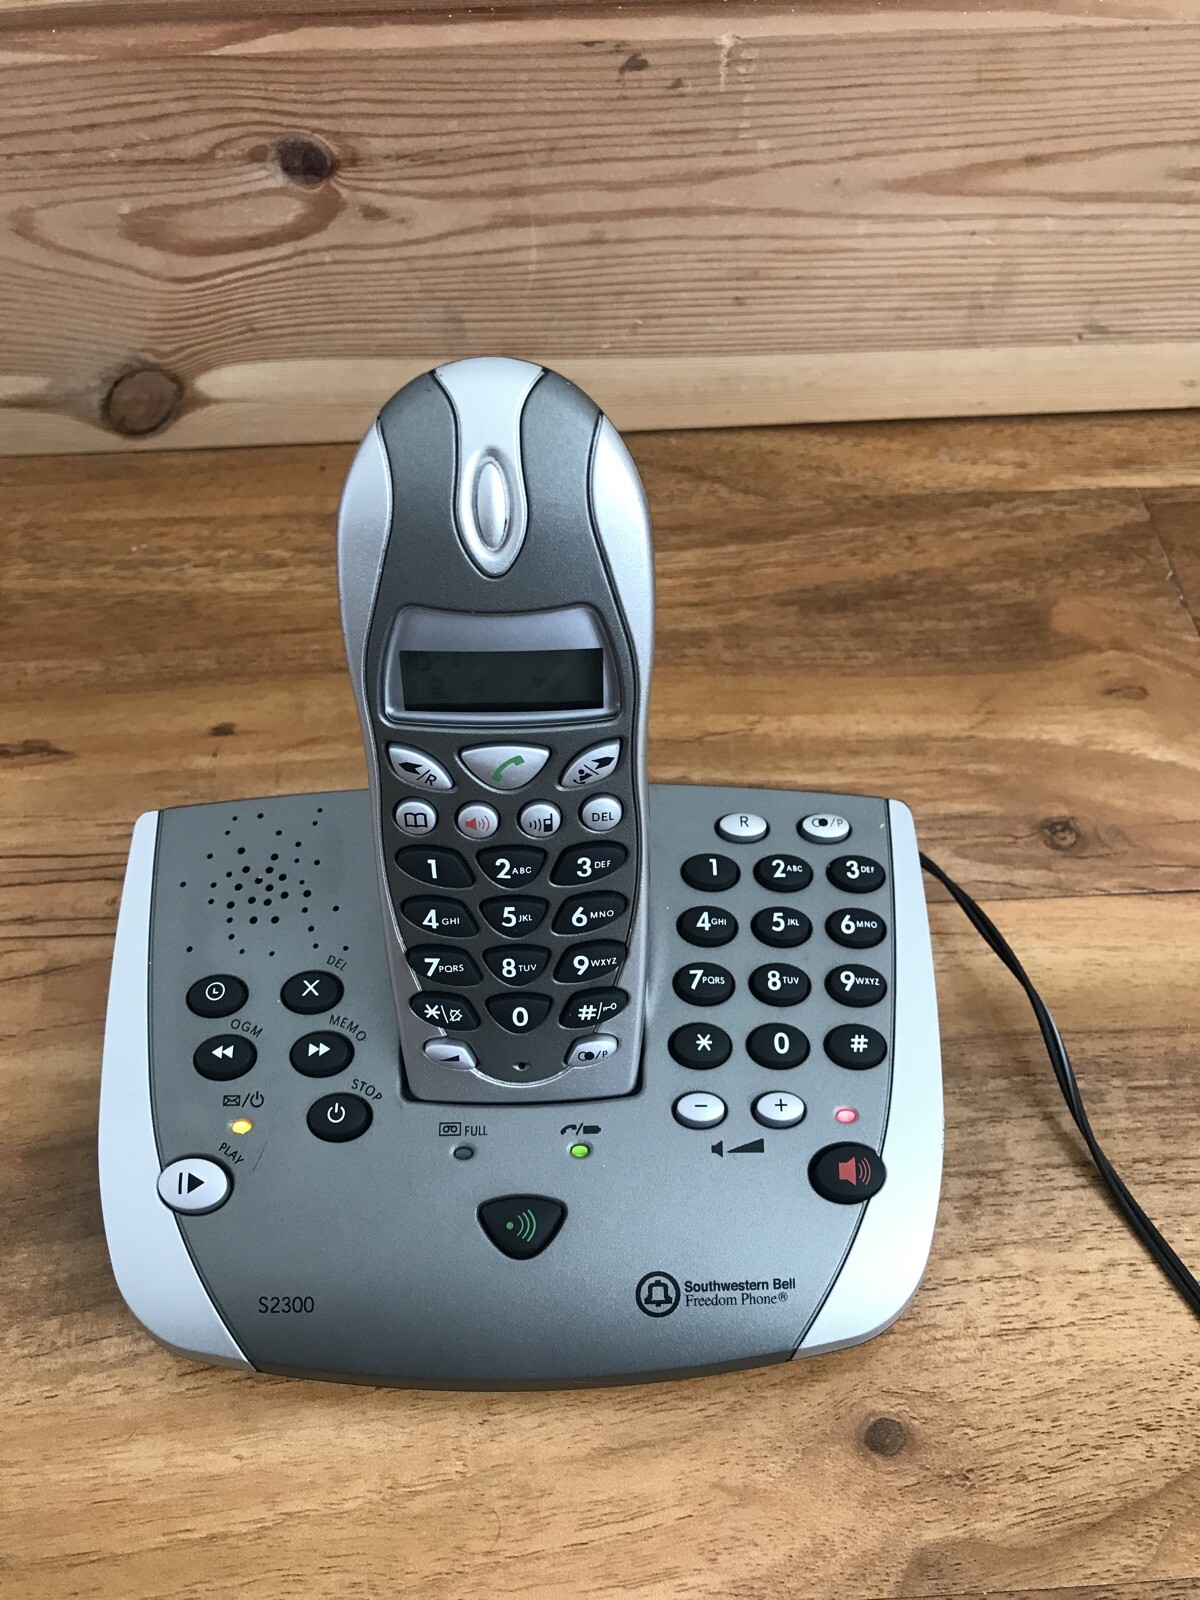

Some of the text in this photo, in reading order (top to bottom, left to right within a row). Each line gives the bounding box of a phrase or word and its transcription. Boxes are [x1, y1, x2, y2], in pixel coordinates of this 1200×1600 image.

[591, 812, 614, 822] DEL
[740, 816, 749, 827] R
[326, 954, 349, 972] DEL
[230, 1019, 264, 1038] OGM
[329, 1014, 367, 1042] MEMO
[351, 1078, 383, 1102] STOP
[464, 1125, 488, 1136] FULL
[218, 1142, 245, 1165] PLAY
[684, 1278, 796, 1293] Southwestern Bell
[258, 1296, 315, 1313] S2300
[685, 1294, 738, 1307] Freedom
